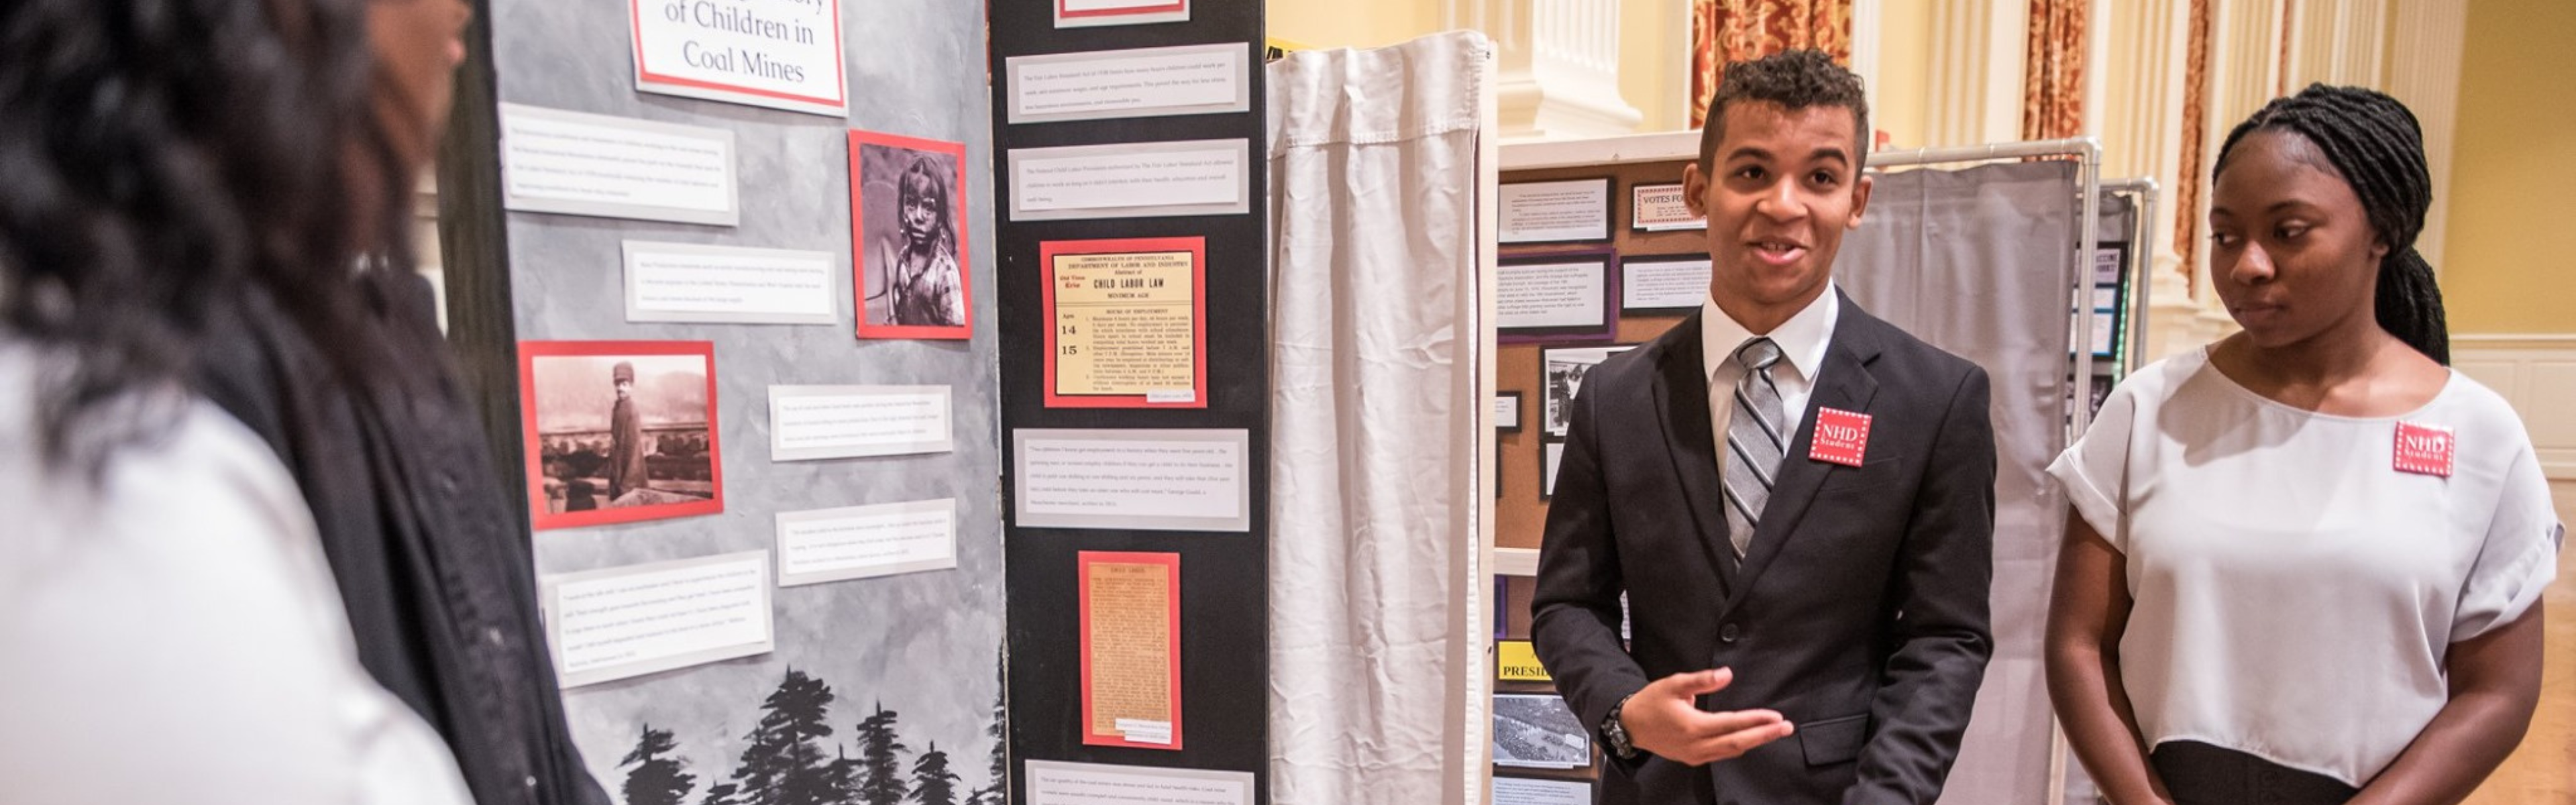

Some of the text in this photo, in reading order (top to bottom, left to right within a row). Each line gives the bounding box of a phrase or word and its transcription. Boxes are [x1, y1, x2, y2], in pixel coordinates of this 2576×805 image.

[665, 3, 686, 23] of
[694, 1, 788, 40] Children
[794, 18, 814, 45] in
[683, 40, 805, 83] Coal Mines
[1643, 195, 1670, 204] VOTES
[1093, 278, 1164, 289] CHILD LABOR LAW
[1062, 325, 1077, 335] 14
[1062, 345, 1077, 356] 15
[1823, 423, 1858, 441] NHD
[2406, 435, 2445, 453] NHD
